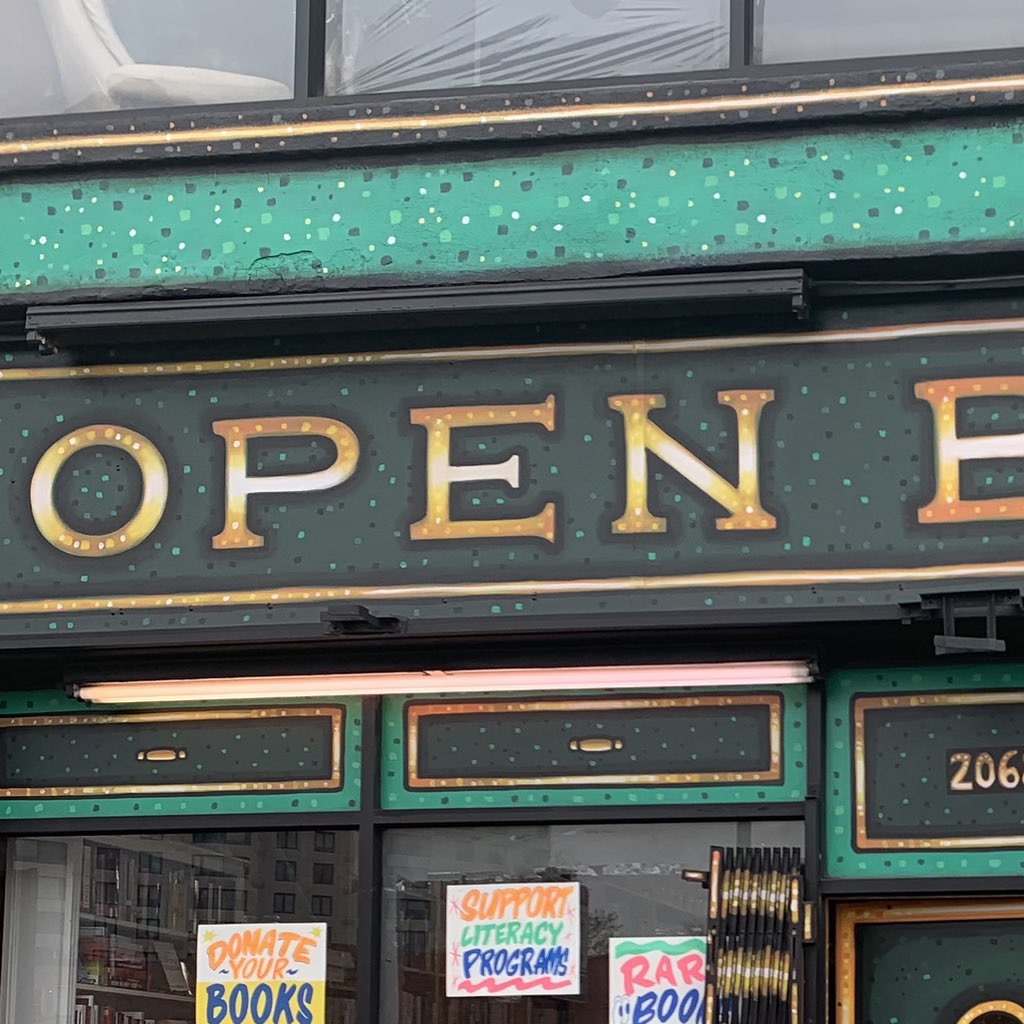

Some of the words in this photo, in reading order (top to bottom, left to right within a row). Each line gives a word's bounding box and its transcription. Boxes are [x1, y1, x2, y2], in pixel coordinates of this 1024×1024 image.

[29, 389, 777, 558] OPEN
[460, 886, 574, 922] SUPPORT
[207, 928, 317, 972] DONATE
[461, 921, 564, 947] LITERACY
[229, 957, 288, 980] YOUR
[463, 946, 569, 979] PROGRAMS
[620, 953, 705, 996] RAR
